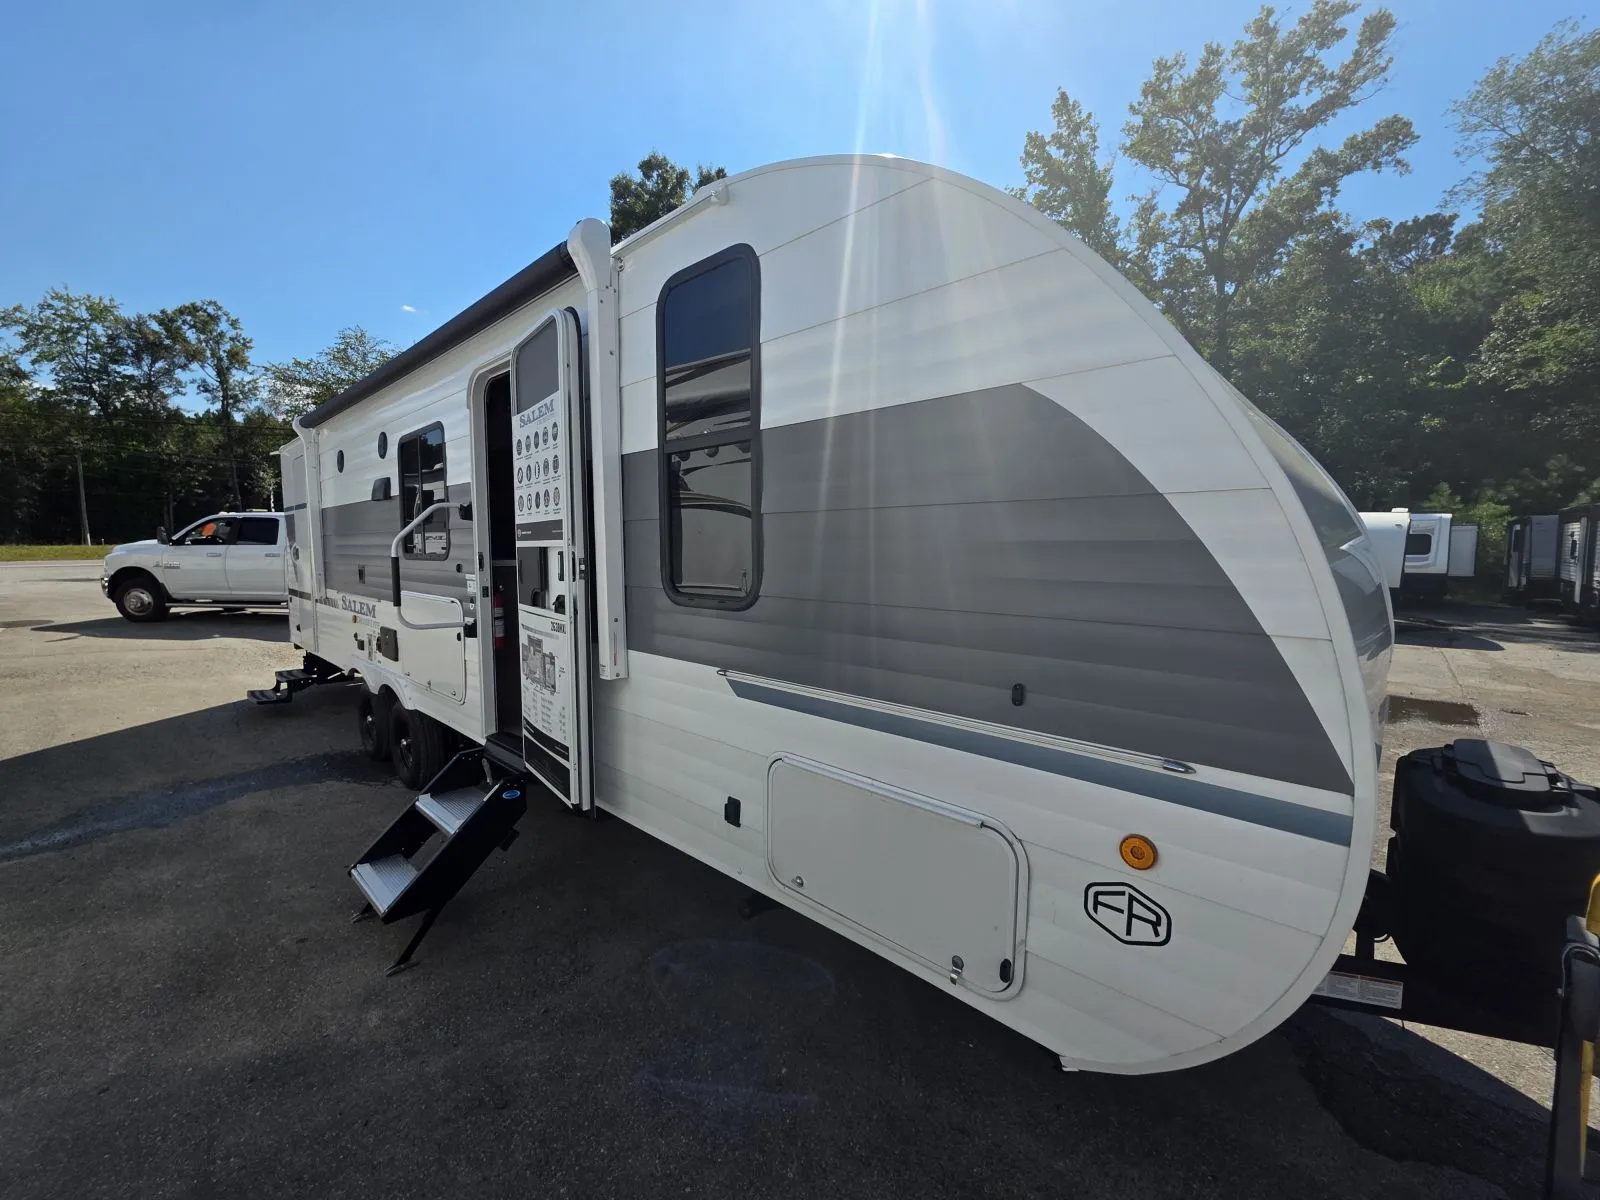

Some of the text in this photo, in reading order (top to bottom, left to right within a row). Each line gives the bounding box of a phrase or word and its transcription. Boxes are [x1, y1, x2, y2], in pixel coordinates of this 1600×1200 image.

[520, 399, 554, 428] SALEM
[342, 595, 376, 618] SALEM
[1093, 891, 1161, 938] FR
